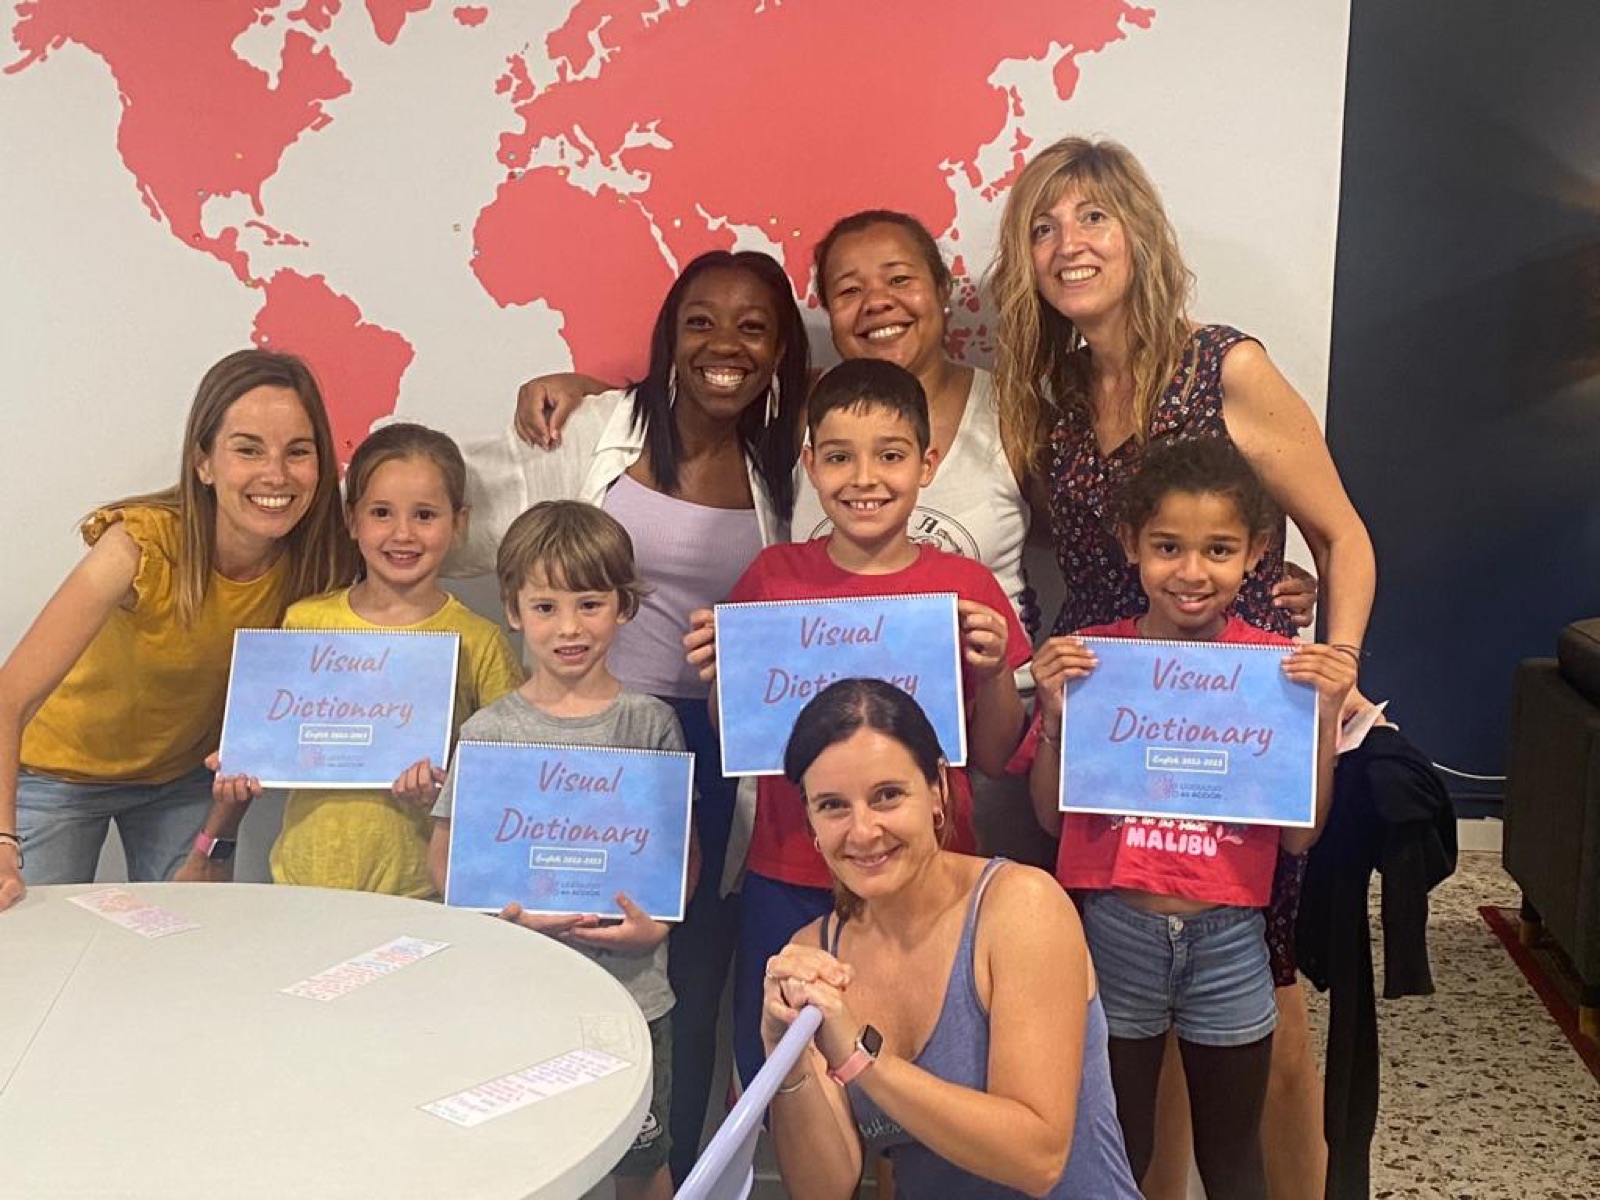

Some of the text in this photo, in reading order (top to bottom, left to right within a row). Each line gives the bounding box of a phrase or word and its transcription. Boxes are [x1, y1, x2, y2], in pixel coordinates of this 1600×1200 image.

[799, 614, 884, 649] Visual
[310, 643, 391, 675] Visual
[1152, 656, 1243, 692] Visual
[764, 668, 919, 704] Dictry
[267, 688, 413, 728] Dictionary
[1110, 707, 1273, 757] Dictionary
[538, 760, 624, 793] Visual
[496, 808, 650, 855] Dictionary
[1126, 826, 1218, 857] MALIBU
